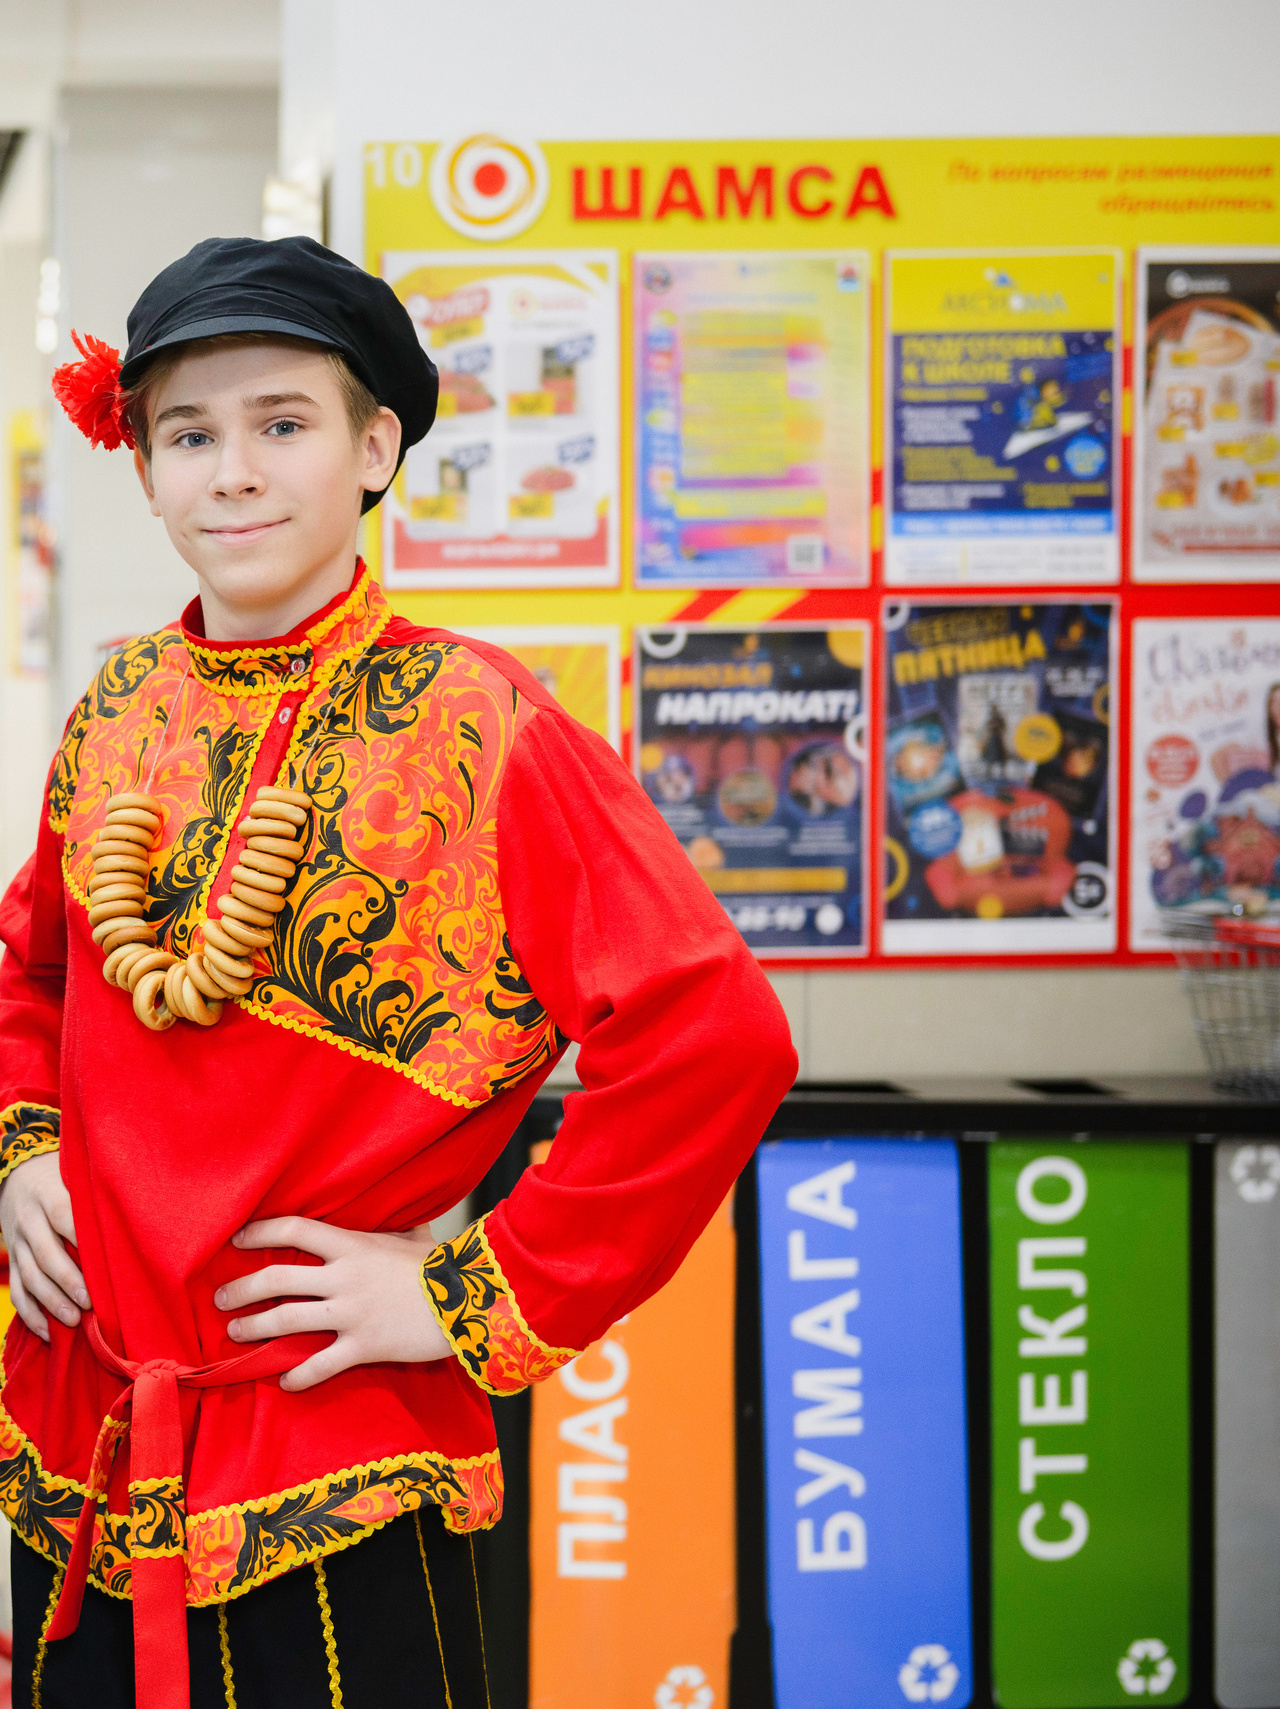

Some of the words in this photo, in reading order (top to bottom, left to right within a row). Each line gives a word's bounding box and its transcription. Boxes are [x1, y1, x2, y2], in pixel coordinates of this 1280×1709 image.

[363, 143, 424, 188] 10
[571, 163, 898, 222] ШАМСА
[902, 335, 1067, 361] ПОДГОТОВКА
[894, 628, 1047, 686] ПЯТНИЦА
[655, 689, 859, 726] НАПРОКАТ!
[787, 1161, 868, 1573] БУМАГА
[1016, 1154, 1090, 1562] СТЕКЛО
[557, 1316, 630, 1580] ПЛАС
